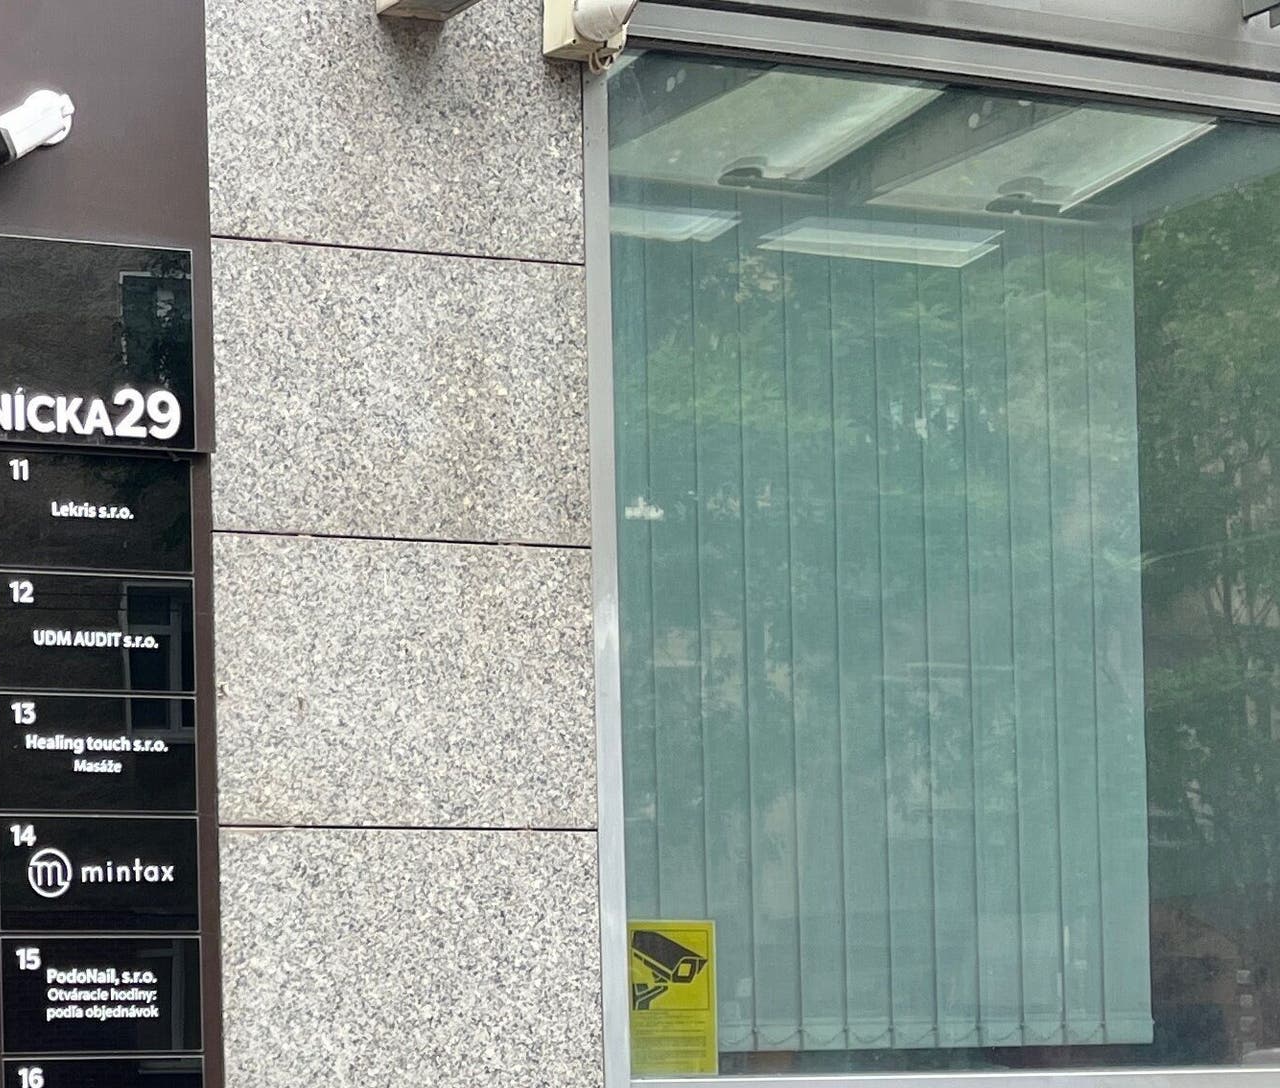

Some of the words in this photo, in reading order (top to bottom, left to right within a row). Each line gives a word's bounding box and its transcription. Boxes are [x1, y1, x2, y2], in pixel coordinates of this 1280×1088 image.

[9, 459, 29, 480] 11
[51, 501, 96, 518] Lekris
[99, 506, 134, 519] s.r.o.
[9, 581, 34, 603] 12
[33, 630, 72, 646] UDM
[74, 631, 122, 647] AUDIT
[123, 636, 158, 648] s.r.o.
[11, 702, 36, 724] 13
[26, 734, 84, 754] Healing
[86, 736, 131, 751] touch
[133, 740, 168, 752] s.r.o.
[74, 759, 122, 772] Masáže
[10, 825, 36, 846] 14
[81, 858, 174, 882] mintax
[16, 948, 41, 970] 15
[47, 968, 120, 985] PodoNail,
[122, 971, 157, 983] s.r.o.
[48, 988, 109, 1001] Otváracie
[111, 988, 157, 1003] hodiny:
[47, 1005, 83, 1021] podľa
[85, 1005, 158, 1021] objednávok
[18, 1068, 44, 1088] 16
